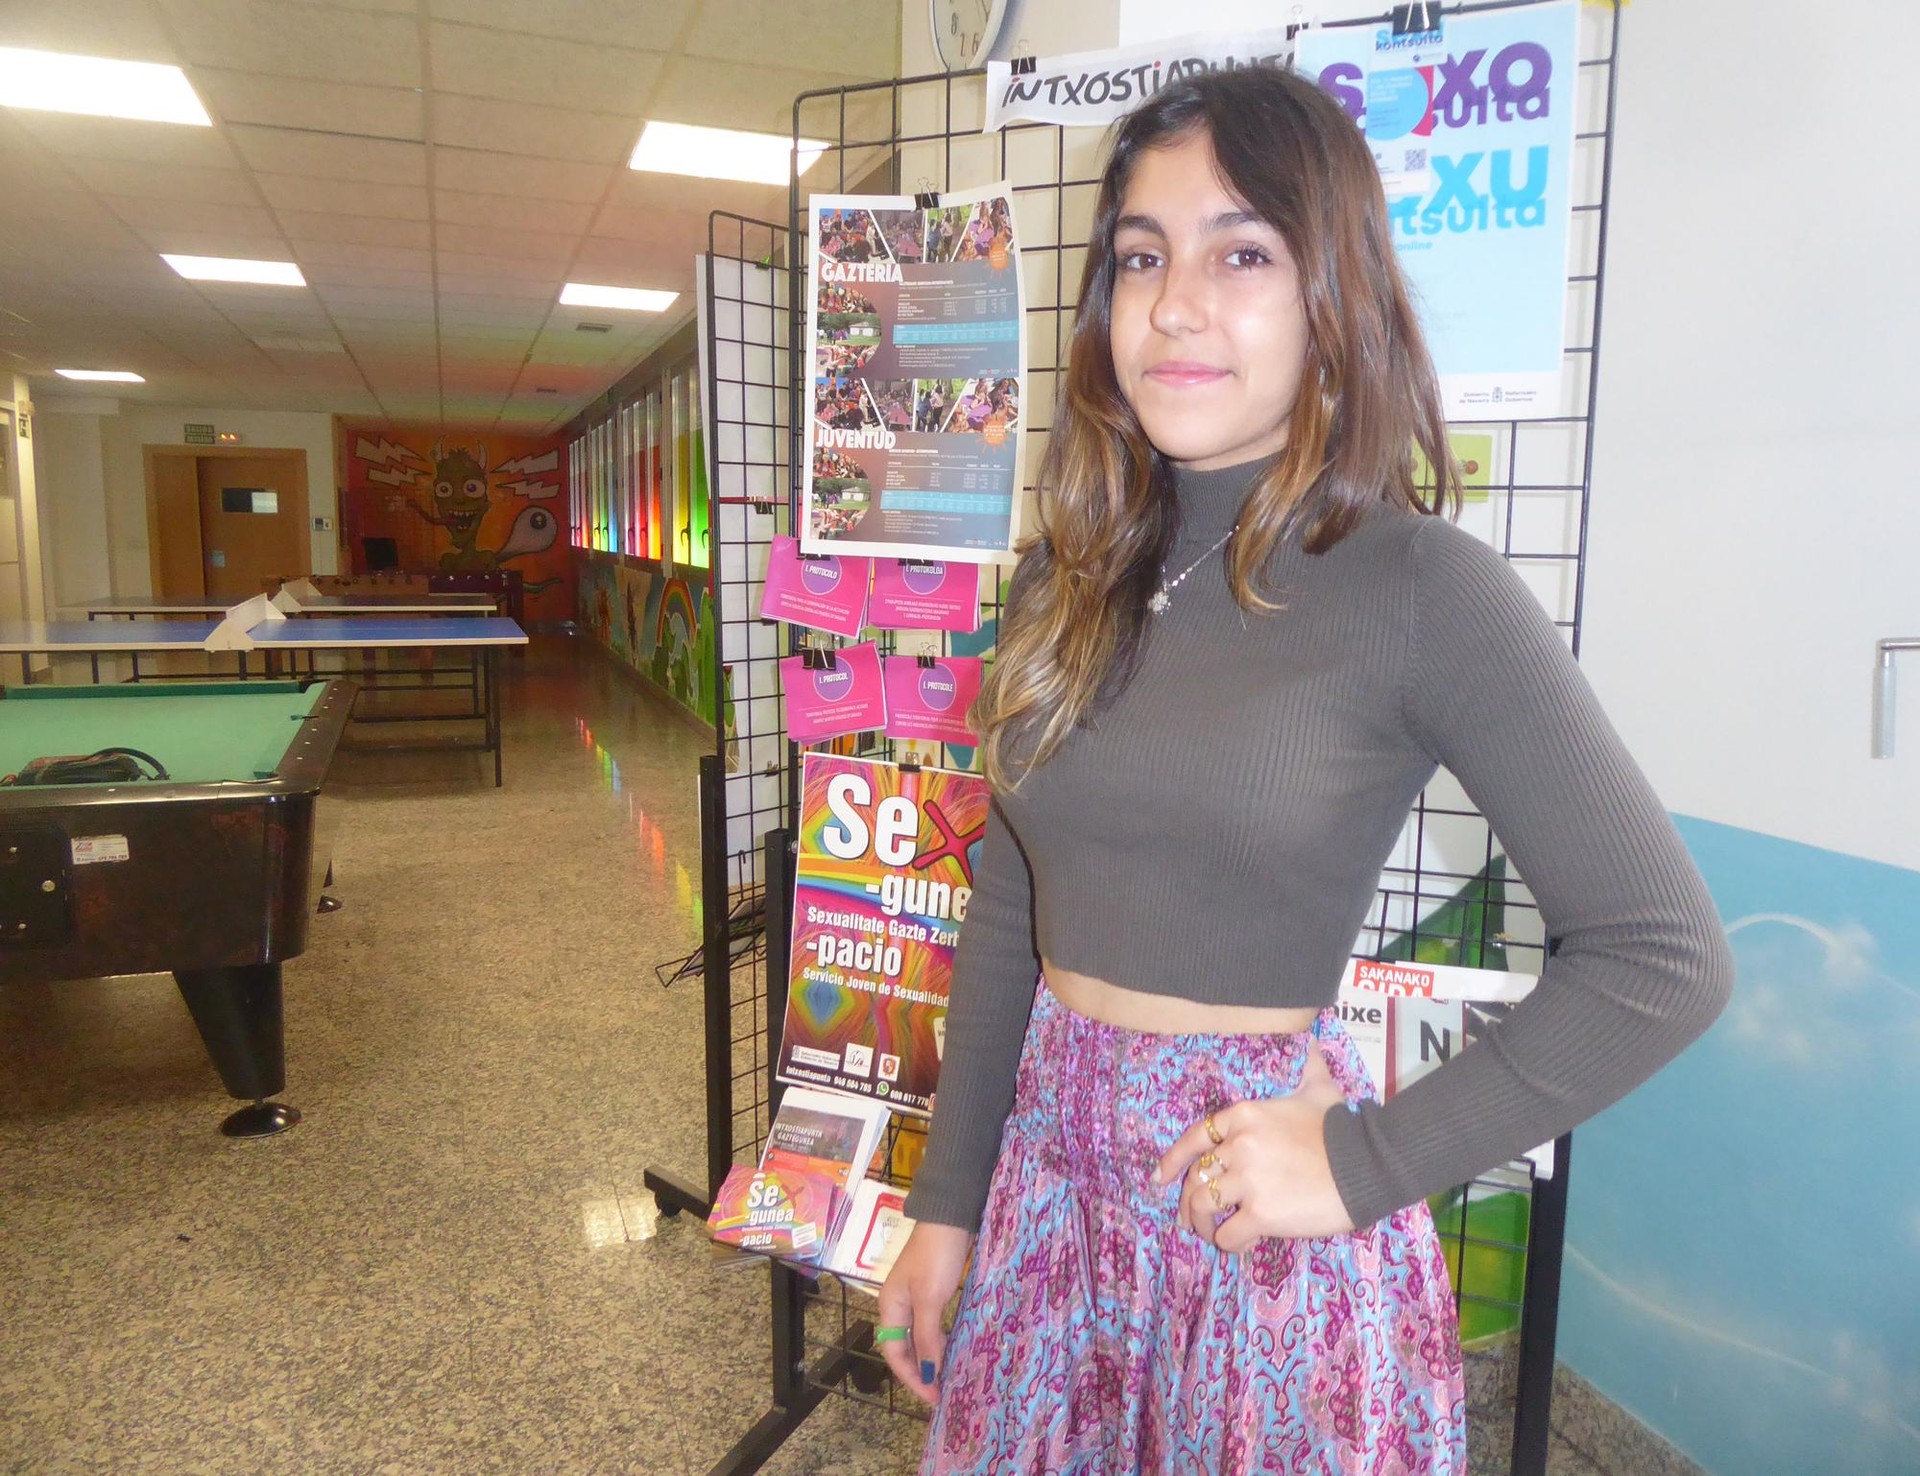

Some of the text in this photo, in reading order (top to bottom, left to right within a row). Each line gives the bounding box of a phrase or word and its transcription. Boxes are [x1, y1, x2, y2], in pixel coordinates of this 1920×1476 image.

[1318, 42, 1552, 114] SXO
[821, 262, 904, 282] GAZTERIA
[815, 430, 897, 450] JUVENTUD
[809, 565, 838, 580] PROTOCOLO
[823, 672, 849, 684] PROTOCOL
[807, 905, 885, 933] Sexualitate
[888, 919, 927, 942] Gazte
[806, 934, 902, 977] -pacio
[802, 966, 949, 1008] Servicio Joven de Sexualidad
[1359, 965, 1430, 988] SAKANAKO
